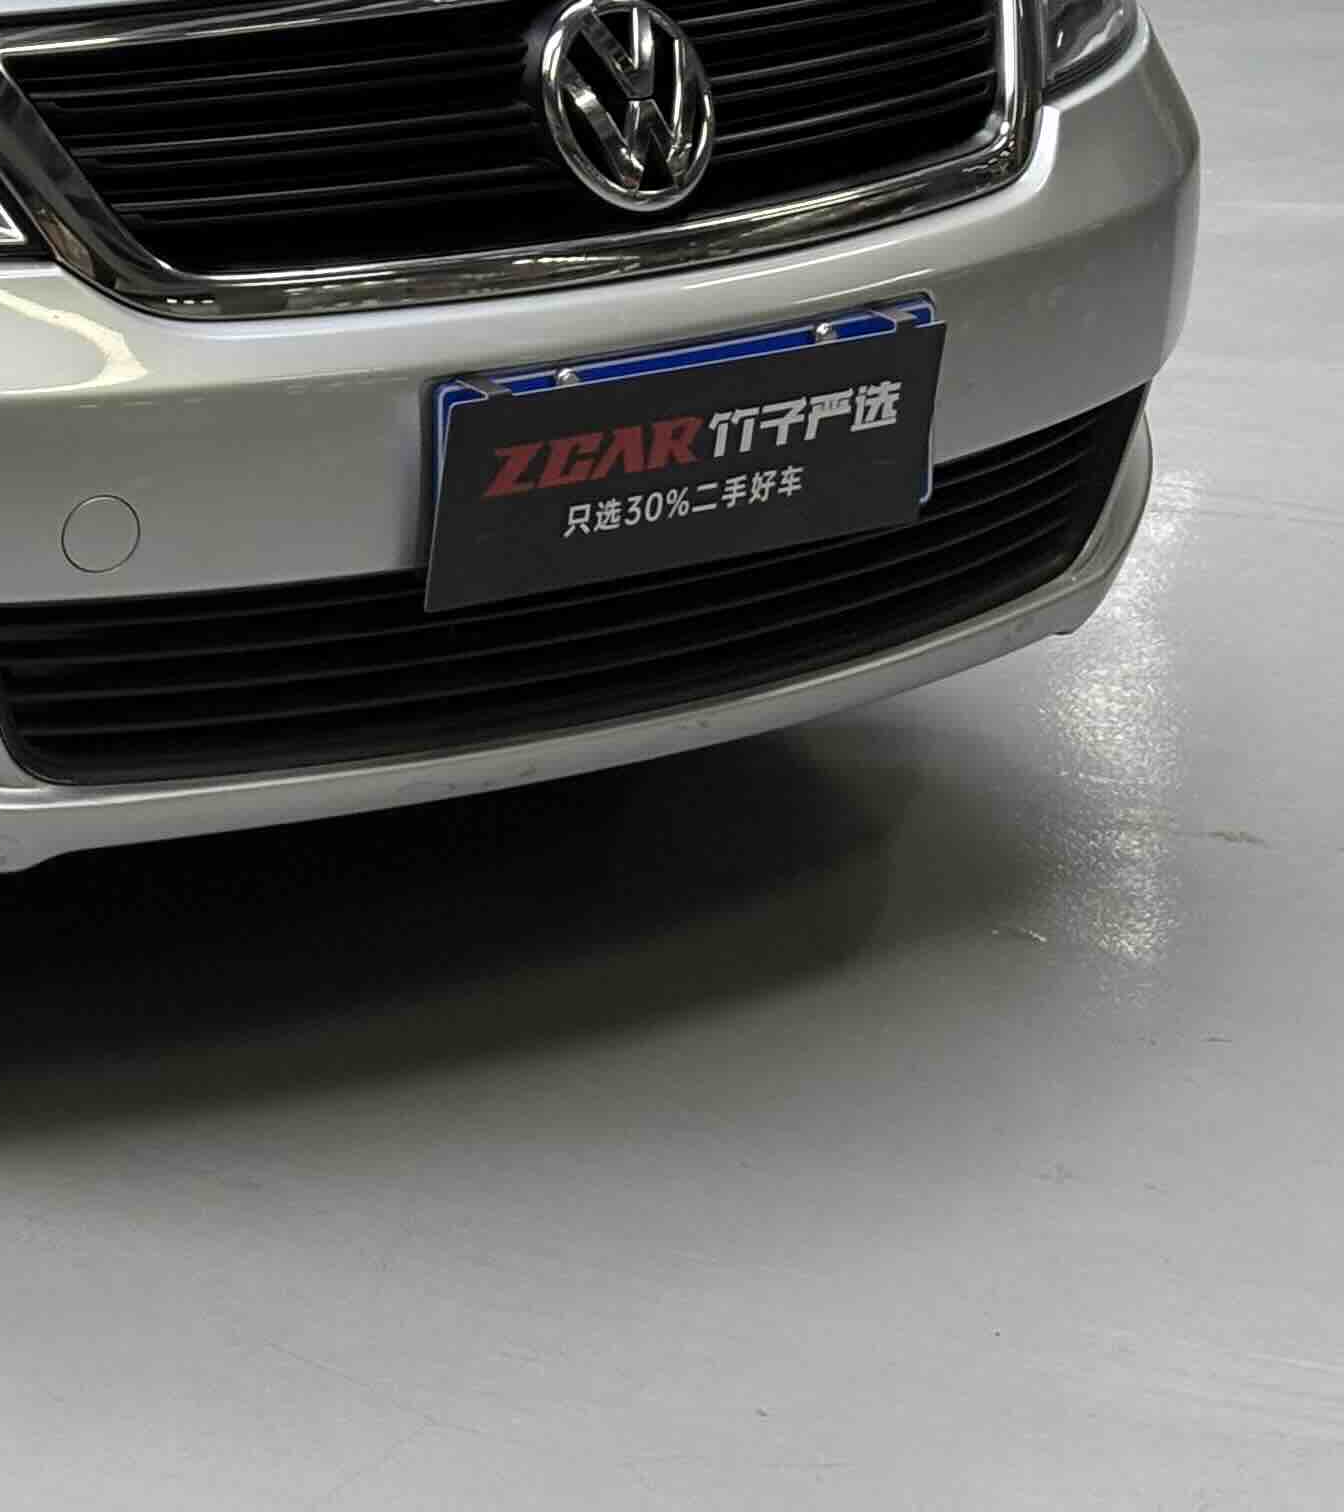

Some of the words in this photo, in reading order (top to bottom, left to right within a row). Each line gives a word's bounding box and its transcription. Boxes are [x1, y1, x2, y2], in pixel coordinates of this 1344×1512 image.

[563, 465, 805, 538] 只选30%二手好车
